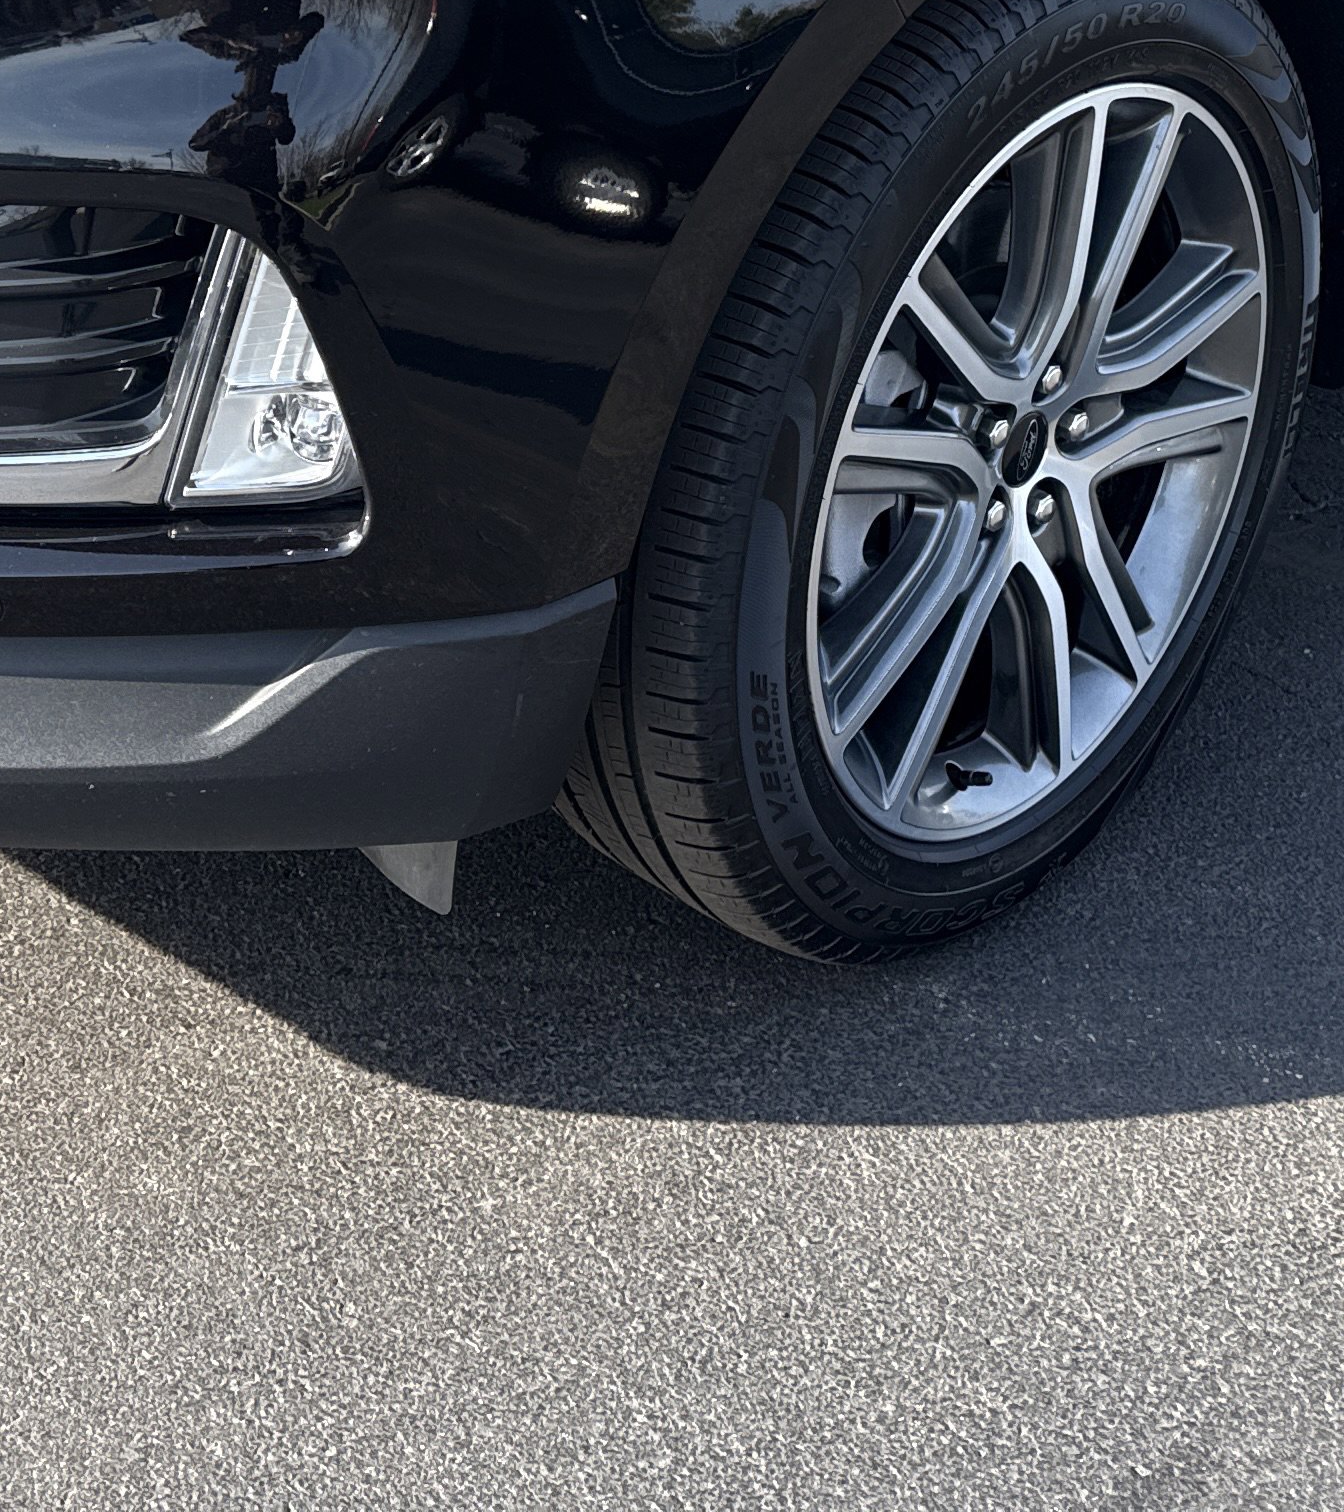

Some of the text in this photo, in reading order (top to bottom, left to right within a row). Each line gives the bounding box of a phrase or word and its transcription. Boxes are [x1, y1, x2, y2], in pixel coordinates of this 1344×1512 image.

[967, 12, 1108, 138] 245/50
[1118, 0, 1188, 30] R20
[1019, 430, 1037, 471] Ford
[749, 670, 1026, 938] SCORPION VERDE
[769, 682, 800, 804] ALL SEASON
